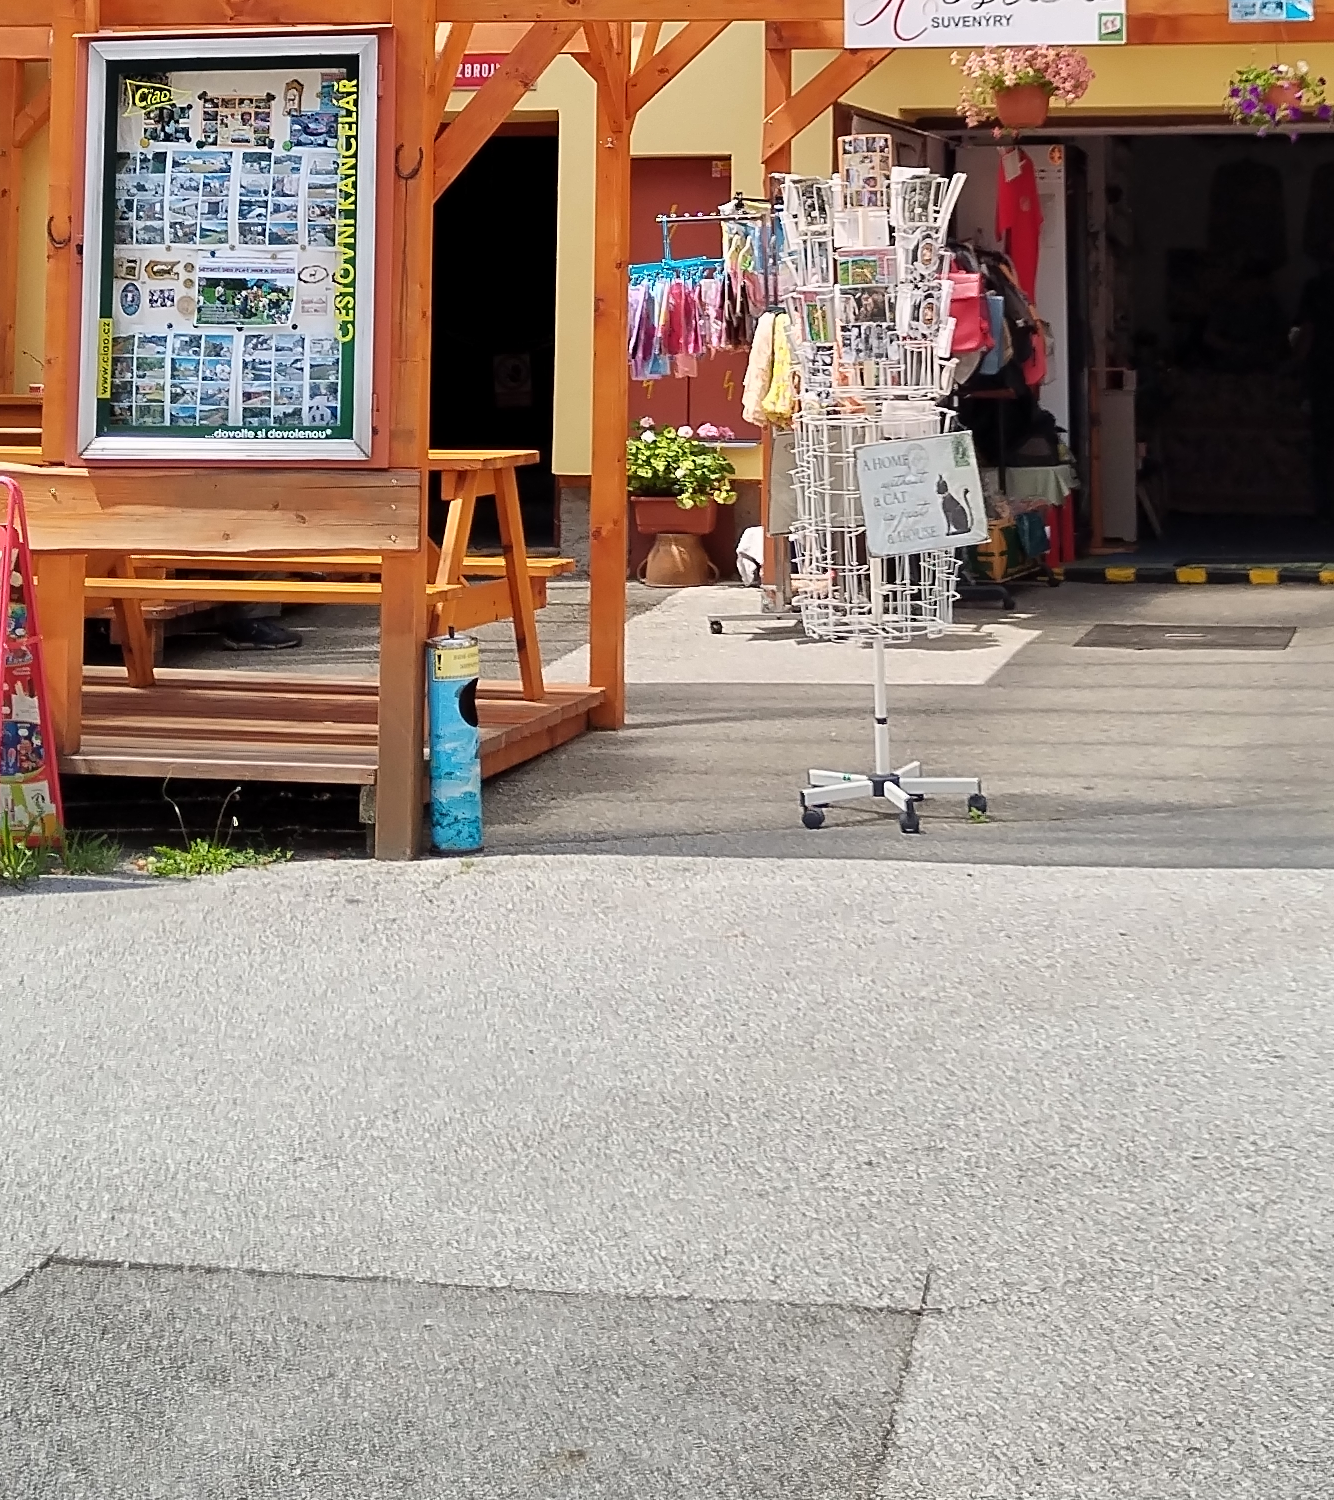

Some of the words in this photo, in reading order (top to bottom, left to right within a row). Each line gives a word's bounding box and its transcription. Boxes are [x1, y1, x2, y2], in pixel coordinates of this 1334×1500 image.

[931, 12, 1013, 29] SUVENÝRY
[332, 79, 358, 209] KANCELÁŘ
[331, 218, 356, 343] CESTOVNÍ
[101, 321, 111, 395] www.ciao.cz
[256, 429, 266, 439] si
[873, 454, 909, 471] HOME
[883, 491, 908, 506] CAT
